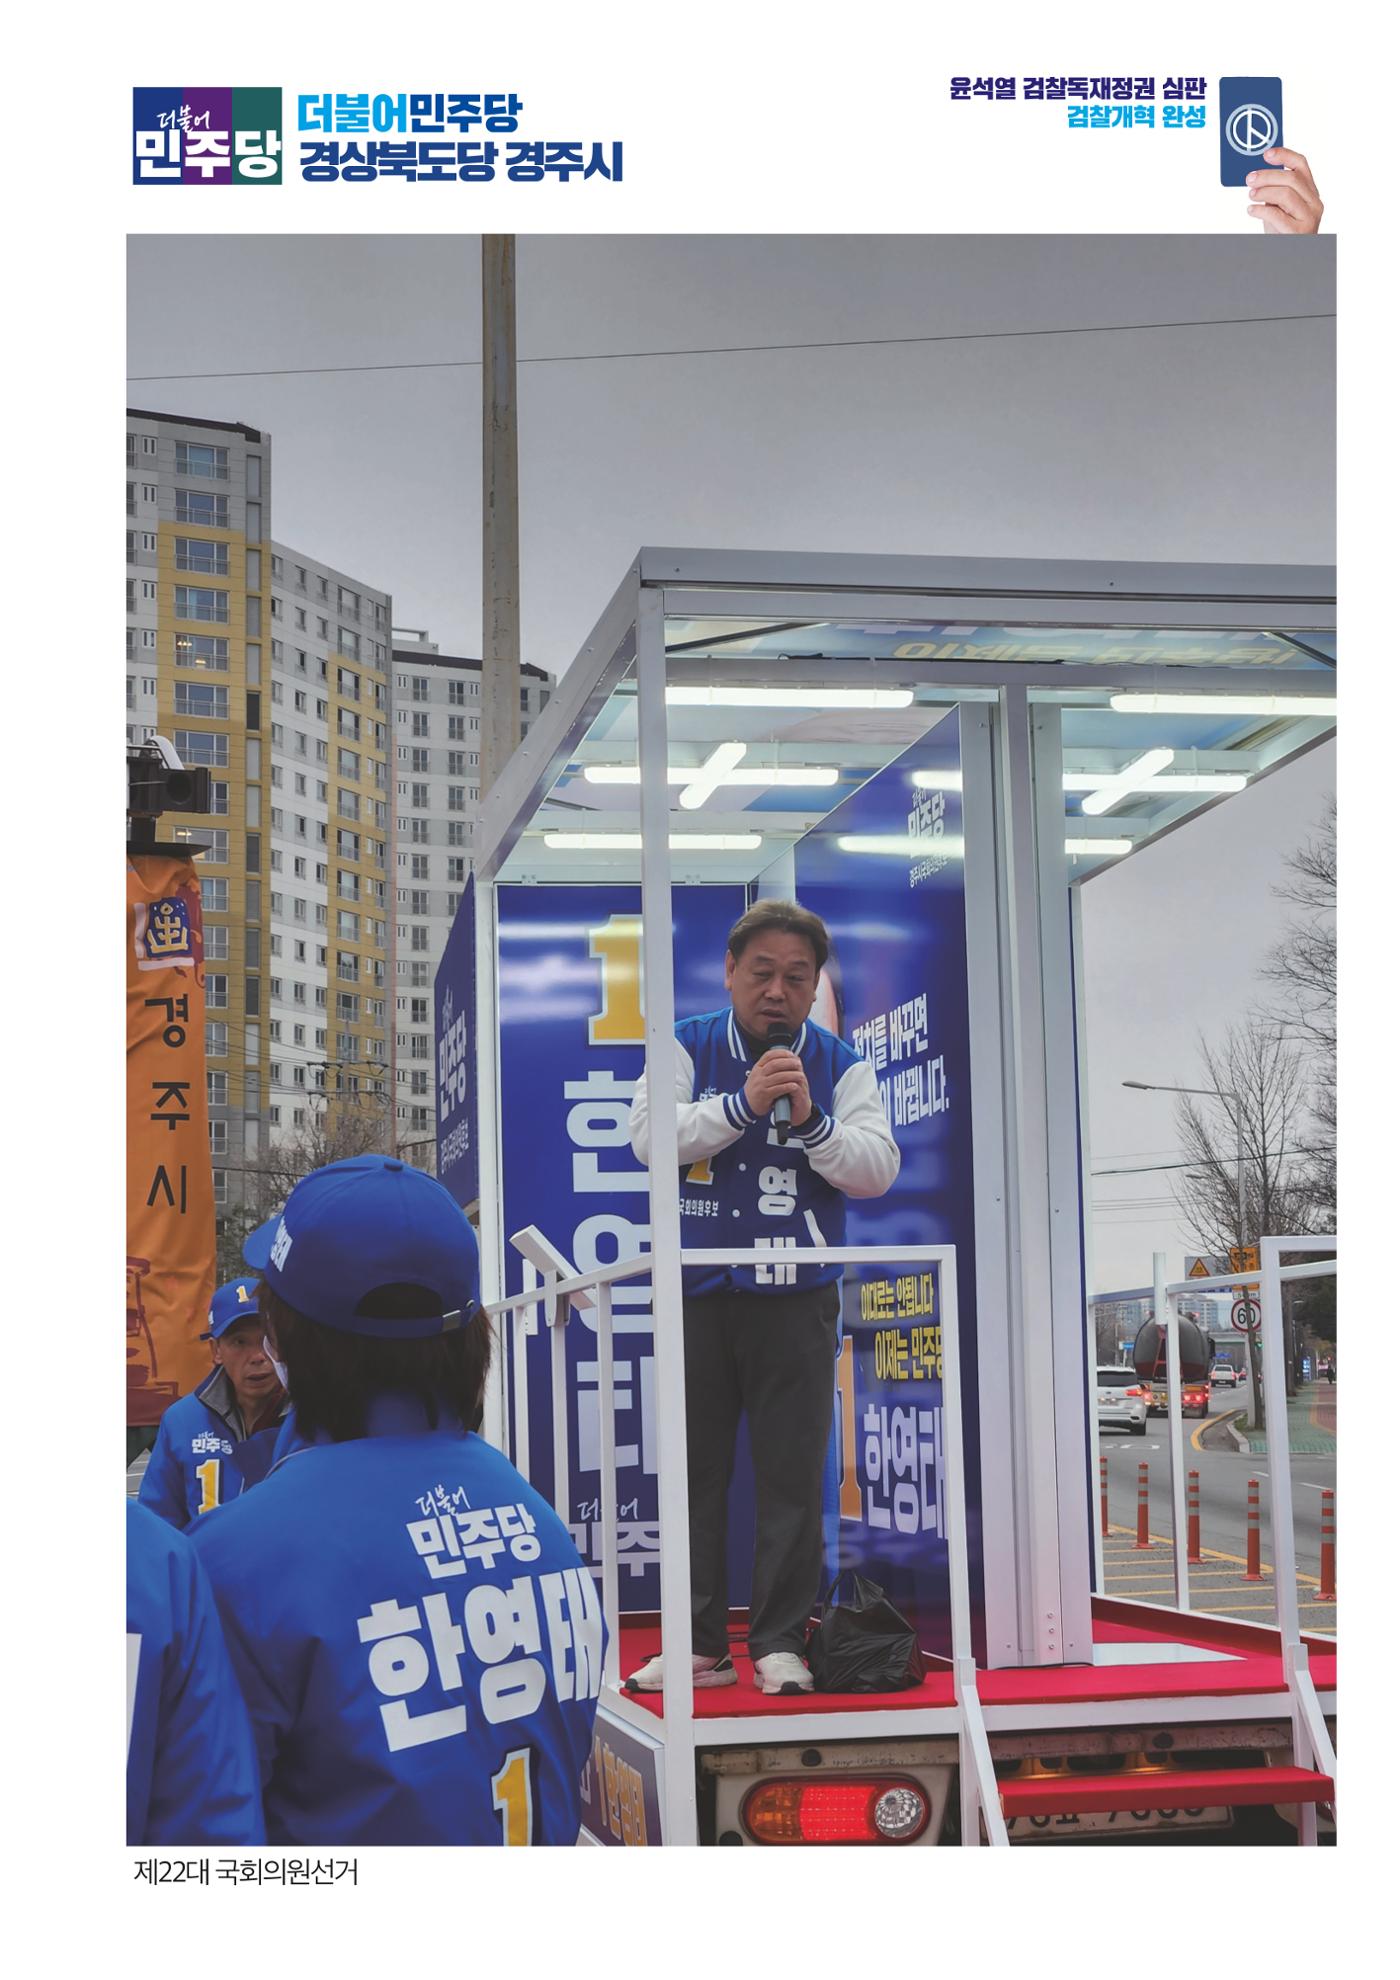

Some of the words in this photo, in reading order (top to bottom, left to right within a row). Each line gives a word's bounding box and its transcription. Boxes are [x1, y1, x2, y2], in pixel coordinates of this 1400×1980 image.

[890, 992, 928, 1062] 바꾸면
[438, 1009, 467, 1123] 민주당
[894, 1054, 950, 1127] 바뀝니다.
[145, 993, 190, 1214] 경주시
[236, 1285, 249, 1304] 1
[861, 1279, 895, 1321] 이대로는
[897, 1272, 934, 1318] 안됩니다
[875, 1328, 909, 1380] 이제는
[836, 1335, 863, 1522] 1
[196, 1458, 221, 1515] 1
[415, 1485, 472, 1516] 더불어
[863, 1403, 949, 1540] 한영태
[406, 1503, 542, 1579] 민주당
[577, 1497, 639, 1521] 더어
[357, 1566, 603, 1753] 한영태
[490, 1747, 533, 1846] 1
